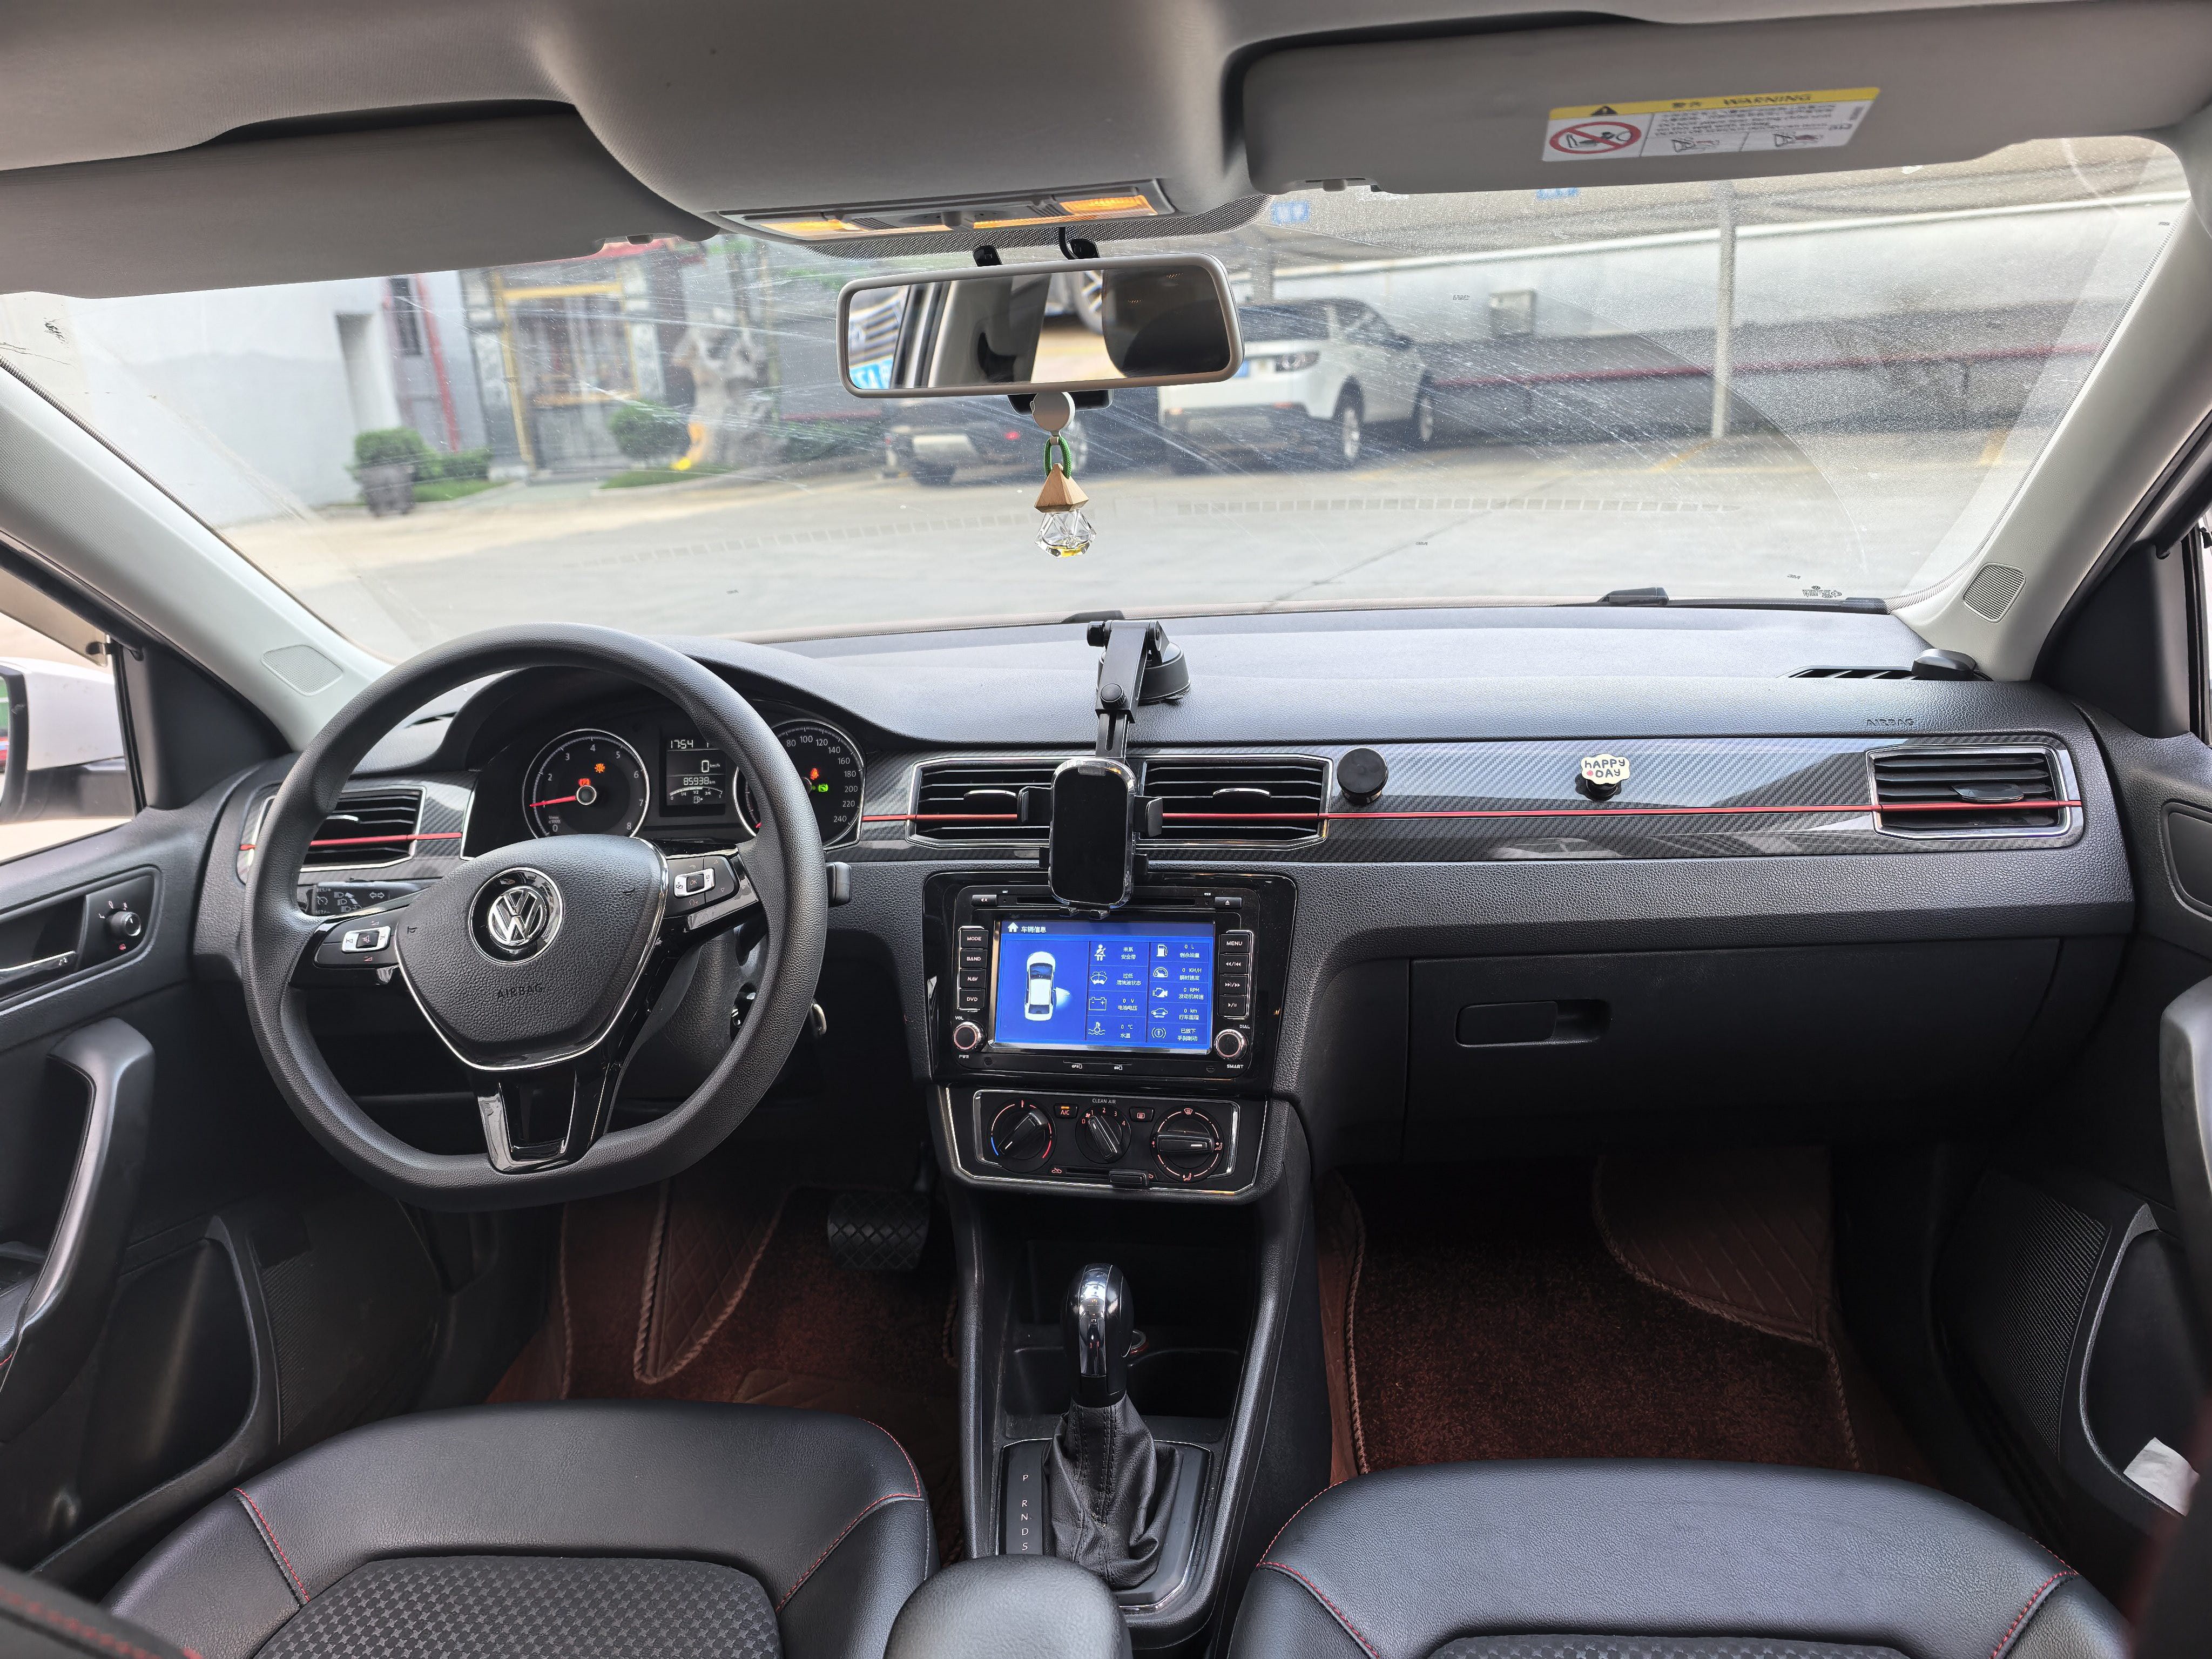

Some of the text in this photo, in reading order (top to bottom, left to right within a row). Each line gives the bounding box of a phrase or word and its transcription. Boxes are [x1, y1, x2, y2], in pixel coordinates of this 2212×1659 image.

[786, 739, 797, 747] 80
[800, 735, 813, 744] 100
[816, 738, 828, 746] 120
[590, 744, 596, 752] 4
[671, 739, 693, 749] 17:54
[828, 746, 841, 755] 140
[565, 752, 570, 761] 3
[616, 751, 621, 759] 5
[838, 757, 851, 765] 160
[702, 760, 710, 773] 0
[548, 773, 553, 782] 2
[633, 771, 639, 779] 6
[552, 824, 558, 832] 0
[626, 822, 632, 831] 8
[496, 983, 544, 1000] AIRBAG
[1021, 1513, 1029, 1521] N
[1022, 1528, 1029, 1536] D
[1022, 1542, 1028, 1551] S
